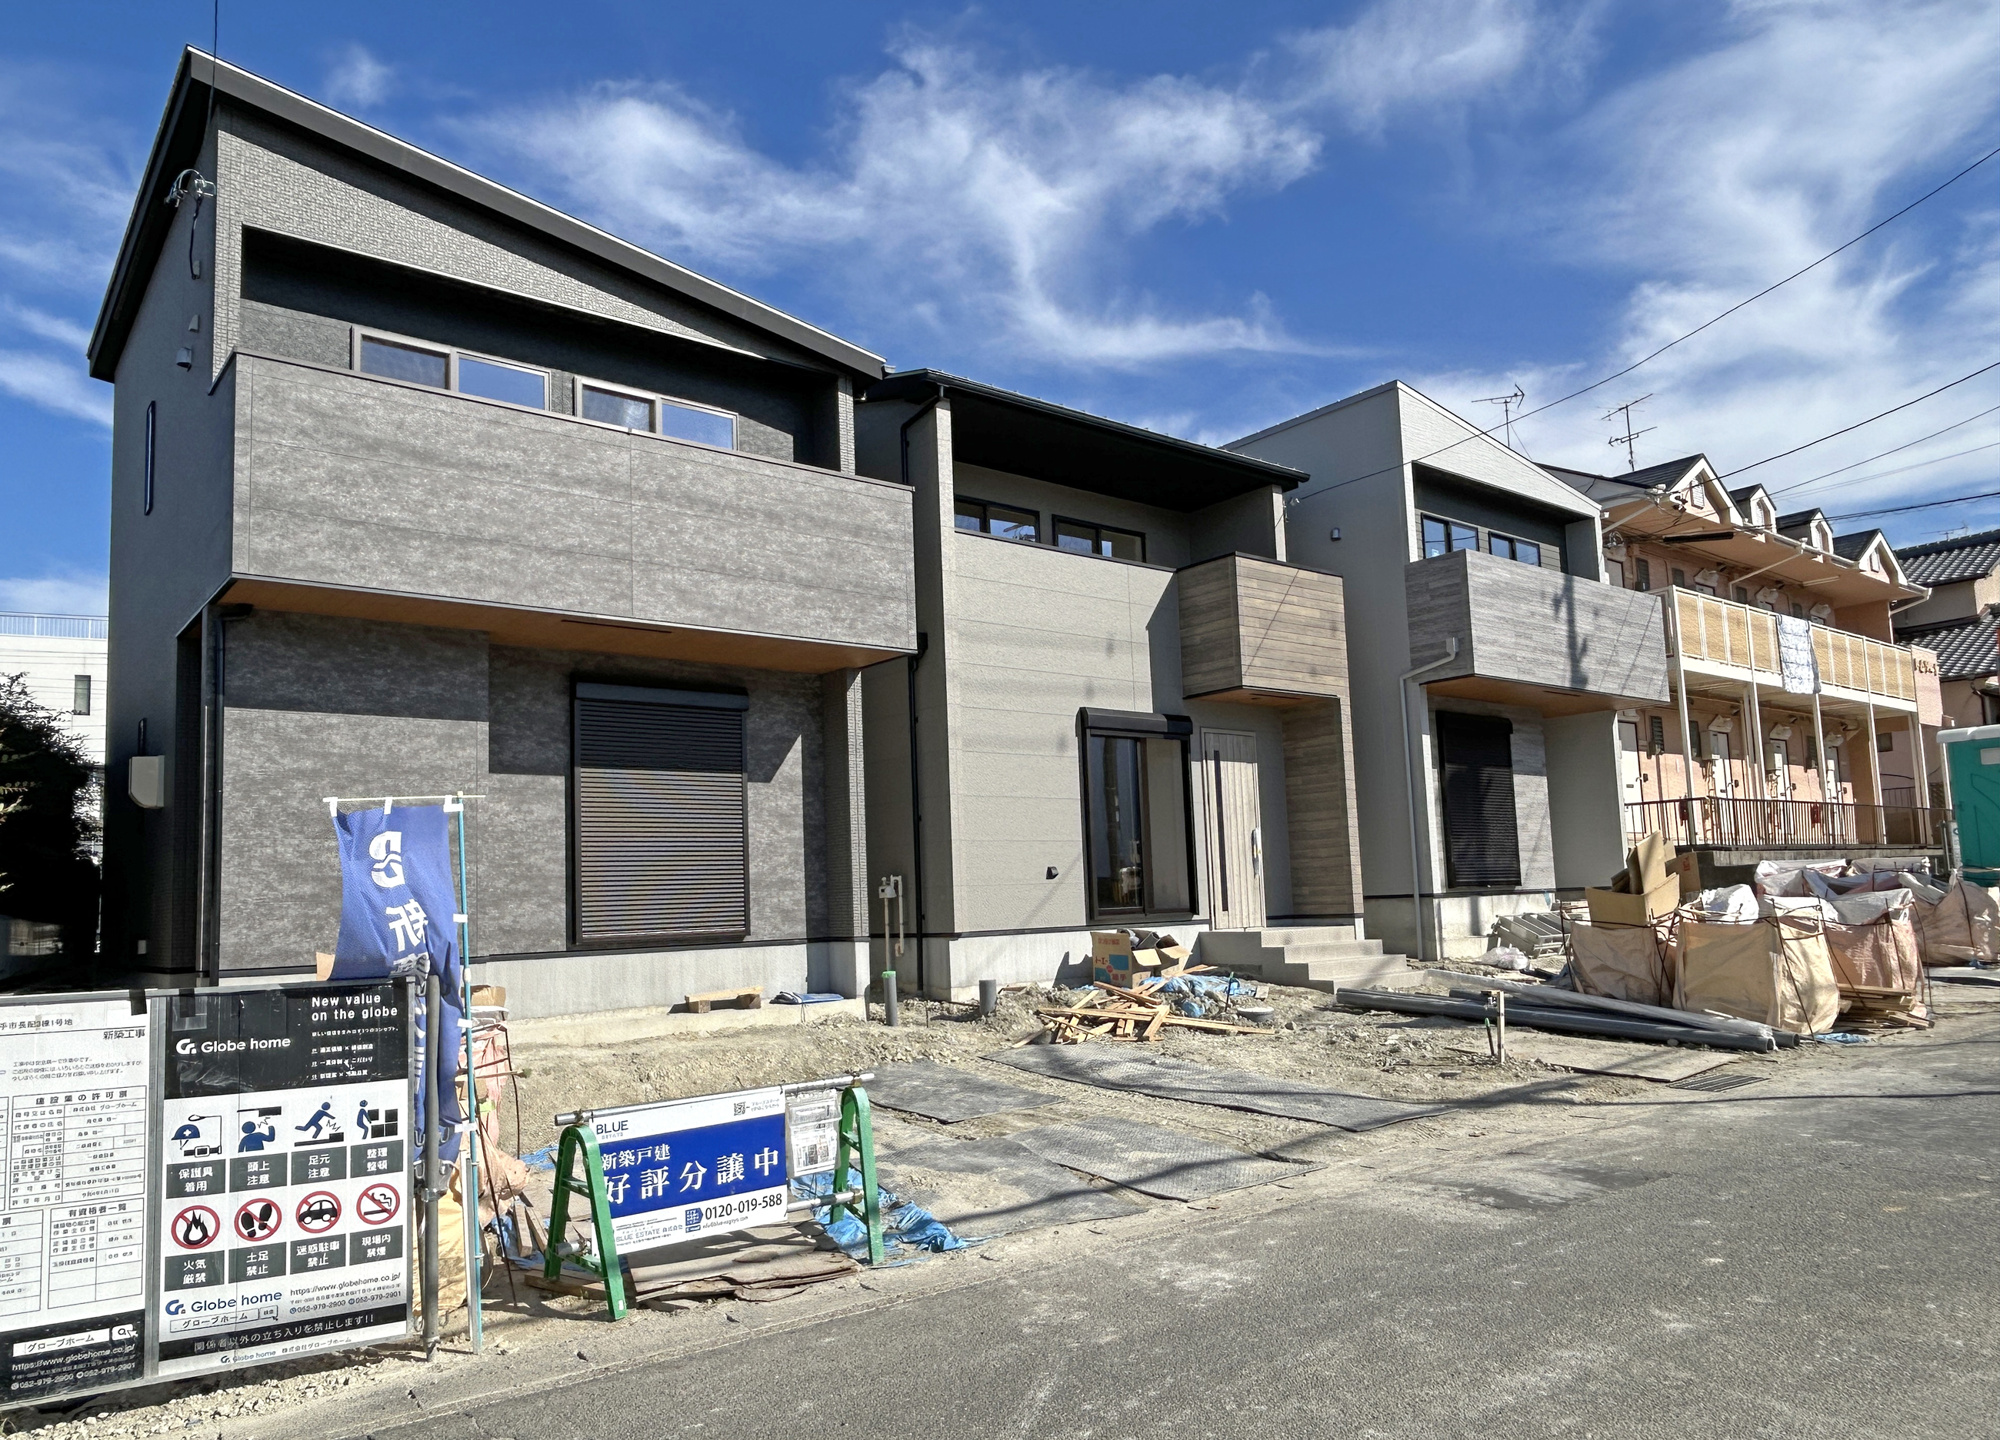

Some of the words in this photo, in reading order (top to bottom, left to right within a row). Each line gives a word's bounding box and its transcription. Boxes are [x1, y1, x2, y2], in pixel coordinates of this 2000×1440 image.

[311, 996, 340, 1008] New
[345, 993, 382, 1006] value
[311, 1010, 328, 1021] on
[334, 1008, 355, 1020] the
[361, 1006, 398, 1019] globe
[102, 1028, 146, 1040] 新築工事
[200, 1040, 246, 1053] Globe
[250, 1037, 291, 1049] home
[596, 1120, 629, 1135] BLUE
[308, 1153, 331, 1165] 足元
[601, 1143, 671, 1171] 新築戸建
[178, 1167, 214, 1179] 保護具
[247, 1161, 270, 1172] 頭上
[308, 1166, 331, 1178] 注意
[246, 1174, 270, 1186] 注意
[604, 1147, 779, 1205] 好評分譲中
[184, 1180, 207, 1192] 着用
[705, 1193, 782, 1220] 0120-019-588
[361, 1233, 391, 1246] 現場内
[246, 1250, 269, 1263] 土足
[307, 1254, 329, 1267] 禁止
[182, 1259, 206, 1271] 火気
[246, 1264, 268, 1276] 禁止
[182, 1272, 206, 1284] 厳禁
[191, 1298, 237, 1312] Globe
[241, 1291, 283, 1306] home
[182, 1312, 248, 1328] グローブホーム
[27, 1335, 95, 1352] グローブホーム
[233, 1352, 254, 1363] Globe
[256, 1350, 277, 1358] home
